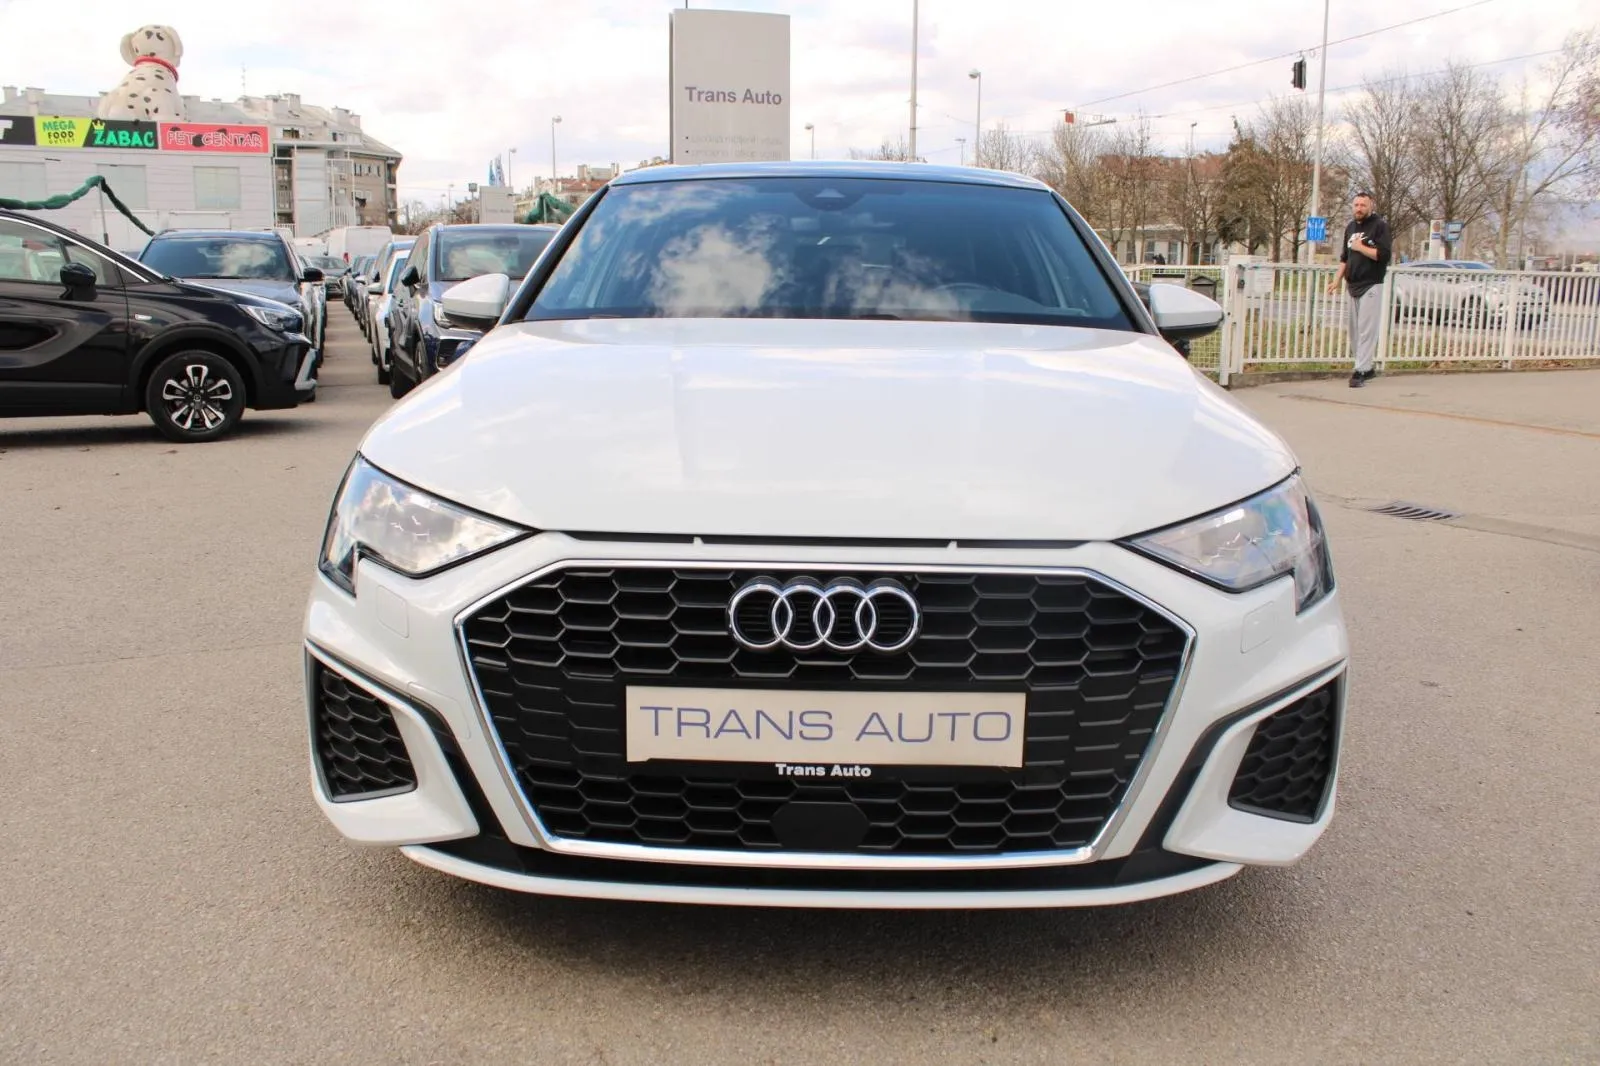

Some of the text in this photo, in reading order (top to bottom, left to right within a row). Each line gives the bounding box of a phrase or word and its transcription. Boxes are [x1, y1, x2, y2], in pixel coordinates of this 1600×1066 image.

[685, 86, 782, 105] Trans Auto
[42, 120, 76, 131] MEGA
[47, 131, 74, 139] FOOD
[167, 131, 262, 147] PET CENTAR
[639, 706, 1012, 743] TRANS AUTO
[775, 763, 872, 777] Trans Auto
